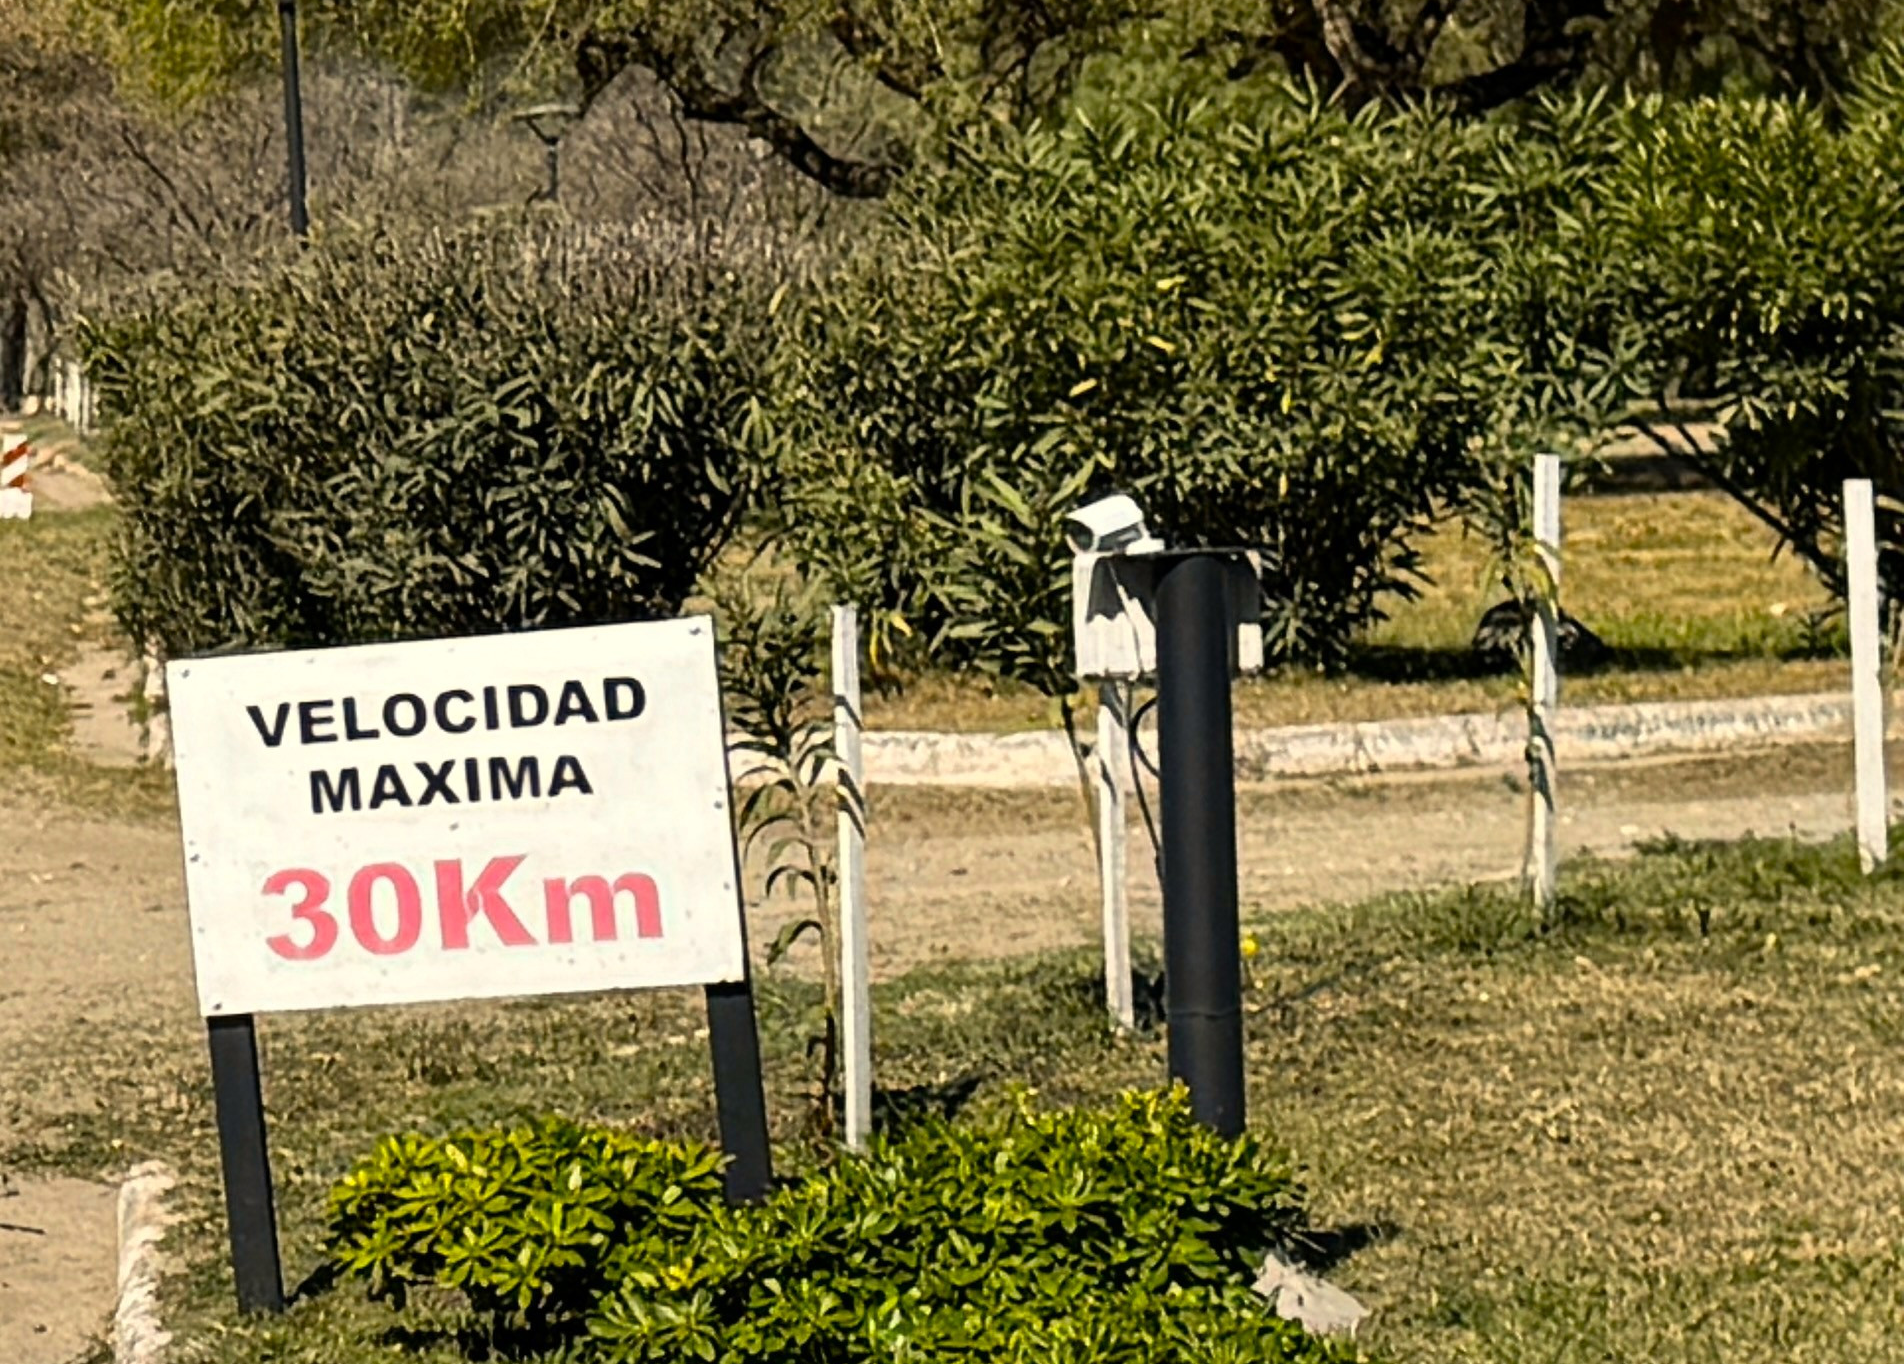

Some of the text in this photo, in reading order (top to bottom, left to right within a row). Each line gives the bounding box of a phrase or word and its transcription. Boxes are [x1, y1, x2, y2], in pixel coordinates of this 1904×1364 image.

[245, 676, 647, 748] VELOCIDAD
[309, 754, 594, 814] MAXIMA
[261, 853, 664, 961] 30Km
